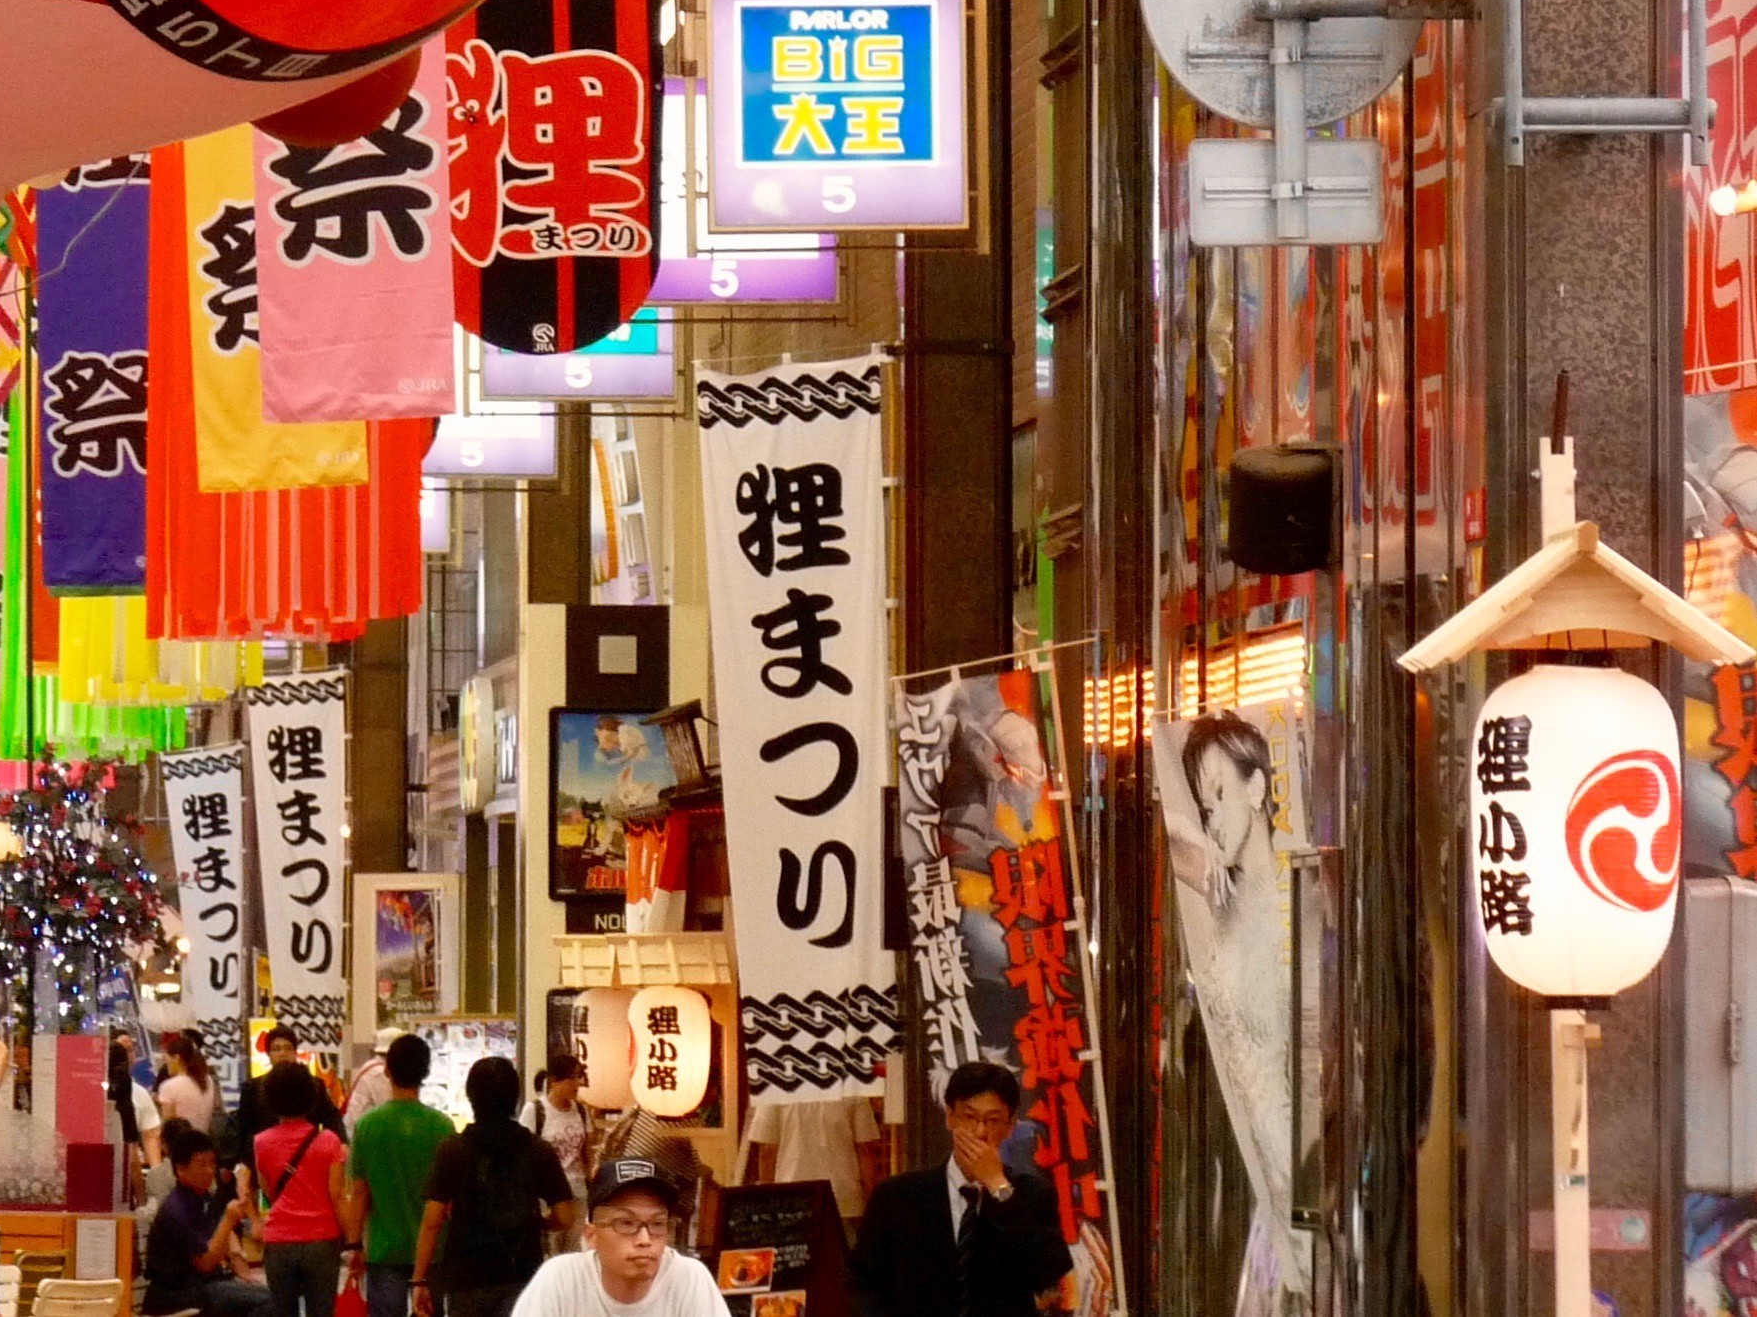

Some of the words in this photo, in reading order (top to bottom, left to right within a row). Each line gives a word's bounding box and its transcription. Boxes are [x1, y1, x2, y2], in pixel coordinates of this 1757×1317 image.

[789, 9, 890, 31] PARLOR
[772, 93, 905, 154] 大王
[822, 175, 857, 213] 5
[533, 221, 637, 253] まつり
[710, 259, 740, 298] 5
[564, 356, 593, 389] 5
[43, 351, 147, 478] 祭
[460, 438, 485, 468] 5
[735, 462, 860, 949] 狸まつり
[268, 724, 333, 974] 狸まつり
[1477, 714, 1535, 937] 狸小路
[182, 792, 240, 1000] 狸まつり
[647, 1005, 682, 1092] 狸小路
